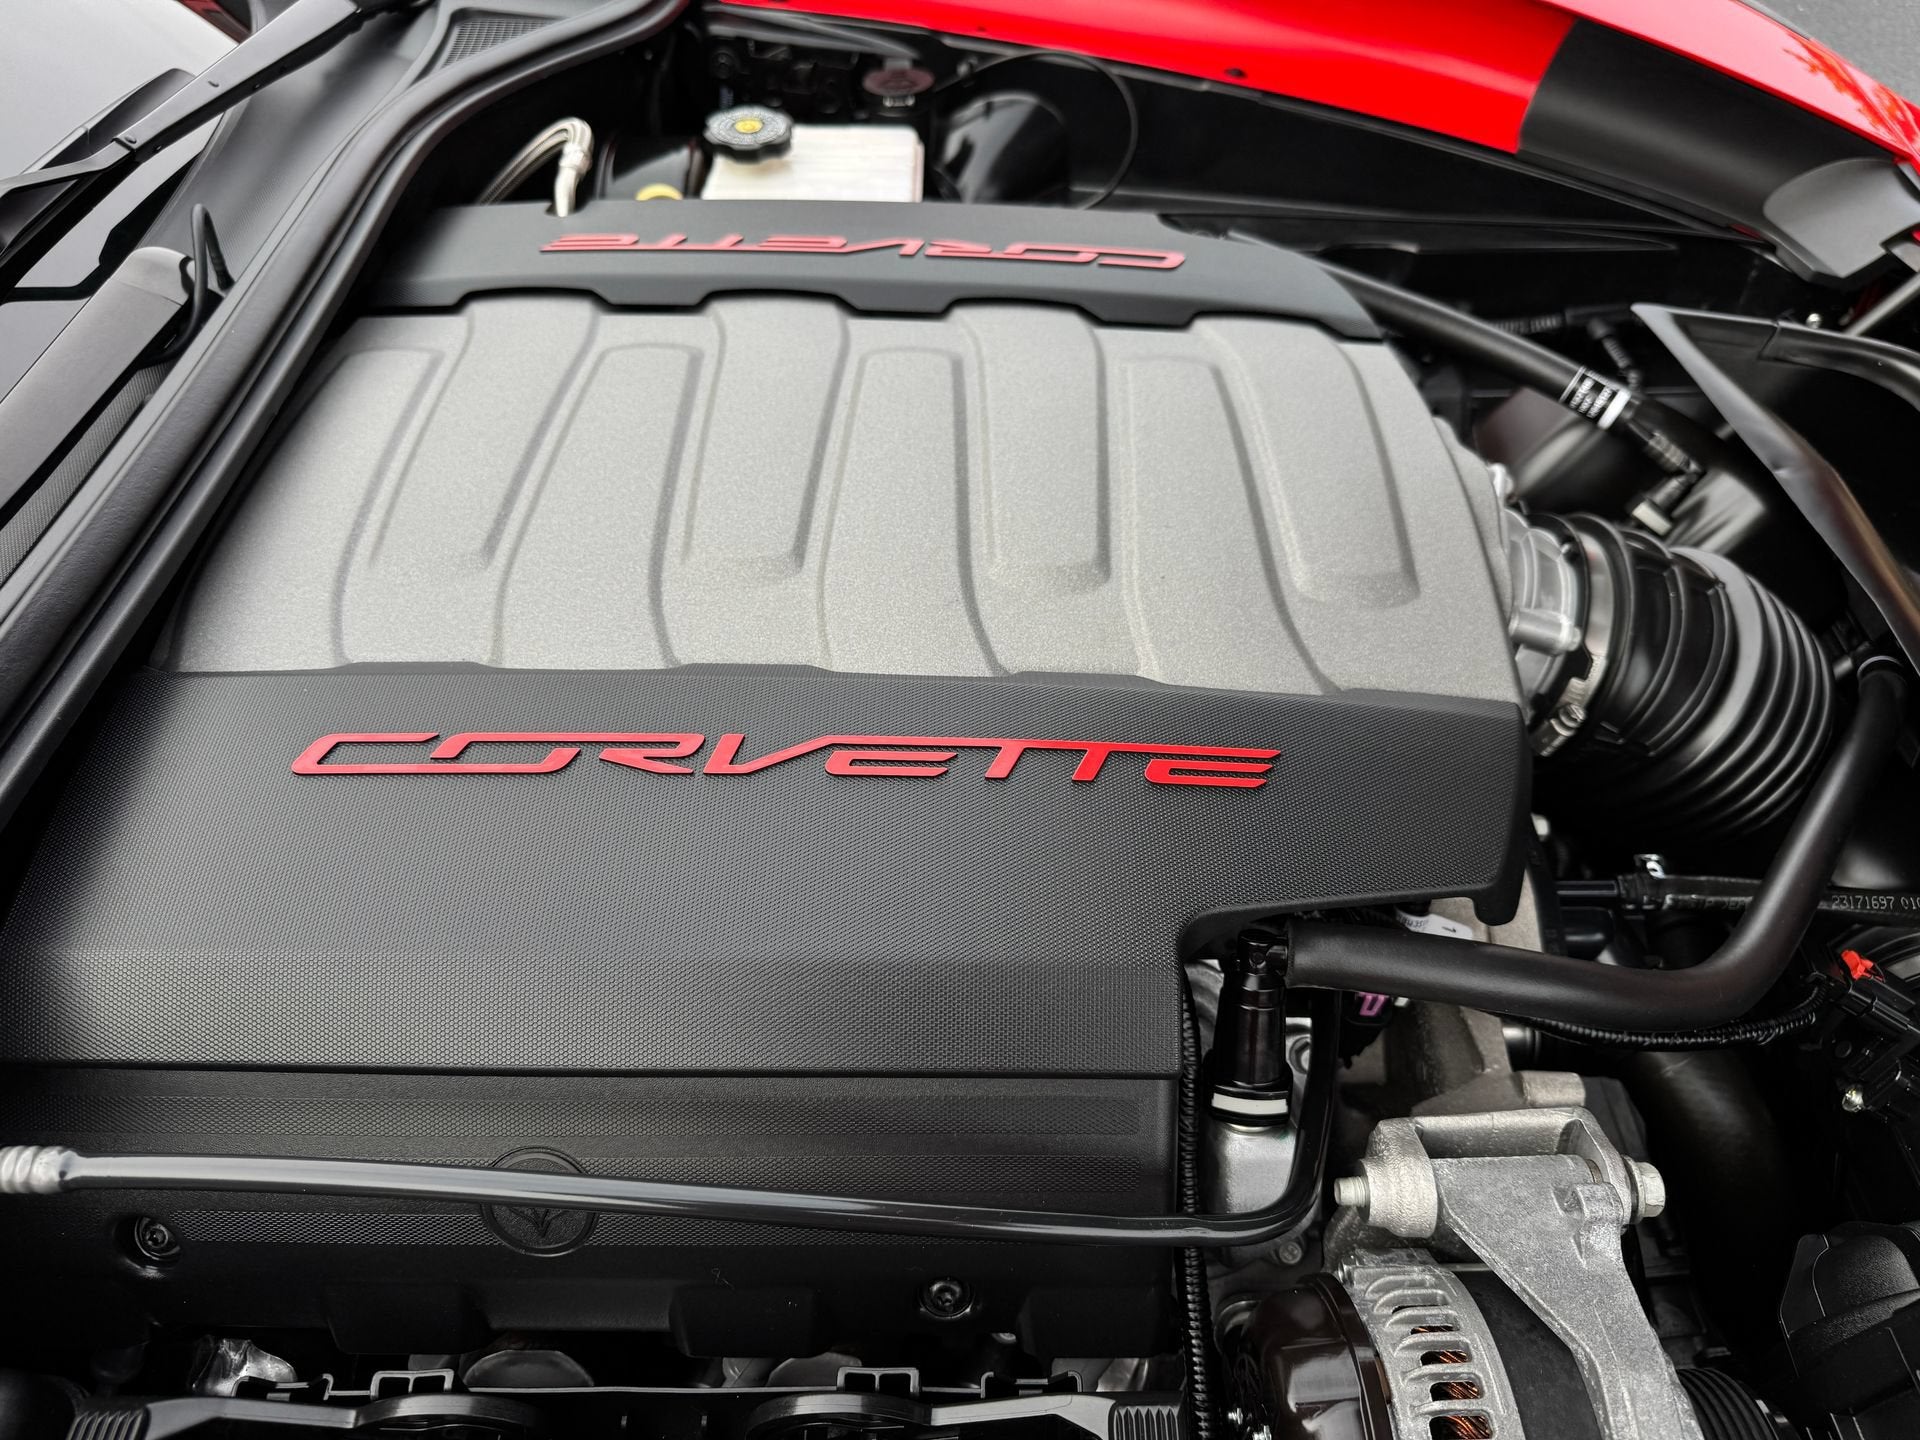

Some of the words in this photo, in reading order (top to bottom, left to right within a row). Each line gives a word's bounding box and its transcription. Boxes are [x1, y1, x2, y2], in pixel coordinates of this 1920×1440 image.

[542, 234, 1186, 269] CORVETTE
[290, 731, 1281, 789] CORVETTE
[1831, 894, 1894, 910] 23171697
